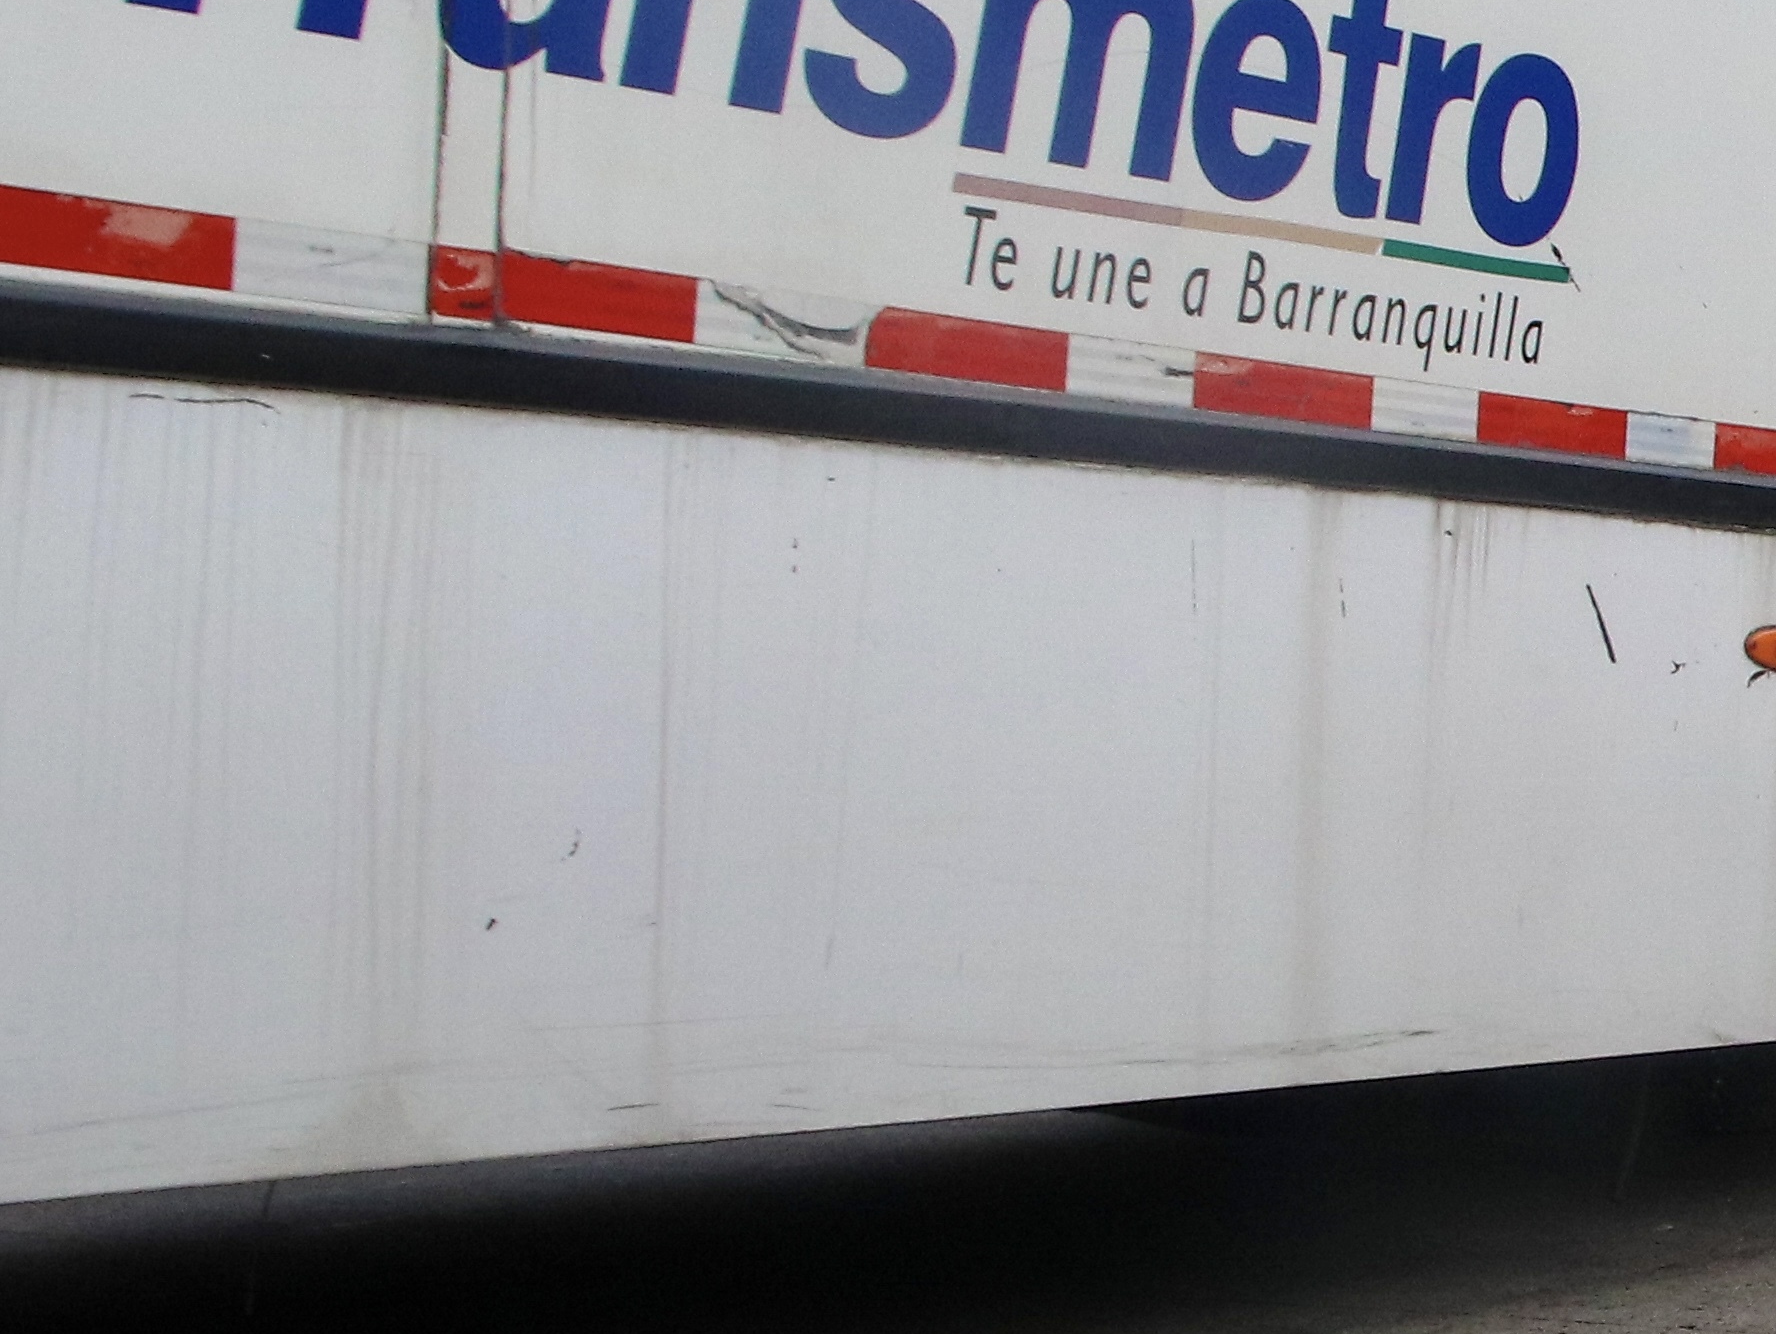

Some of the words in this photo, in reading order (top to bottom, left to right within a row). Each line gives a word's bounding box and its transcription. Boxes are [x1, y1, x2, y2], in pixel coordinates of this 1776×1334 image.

[963, 205, 1019, 291] Te
[1050, 244, 1152, 310] une
[1181, 265, 1211, 318] a
[1236, 250, 1545, 371] Barranquilla
